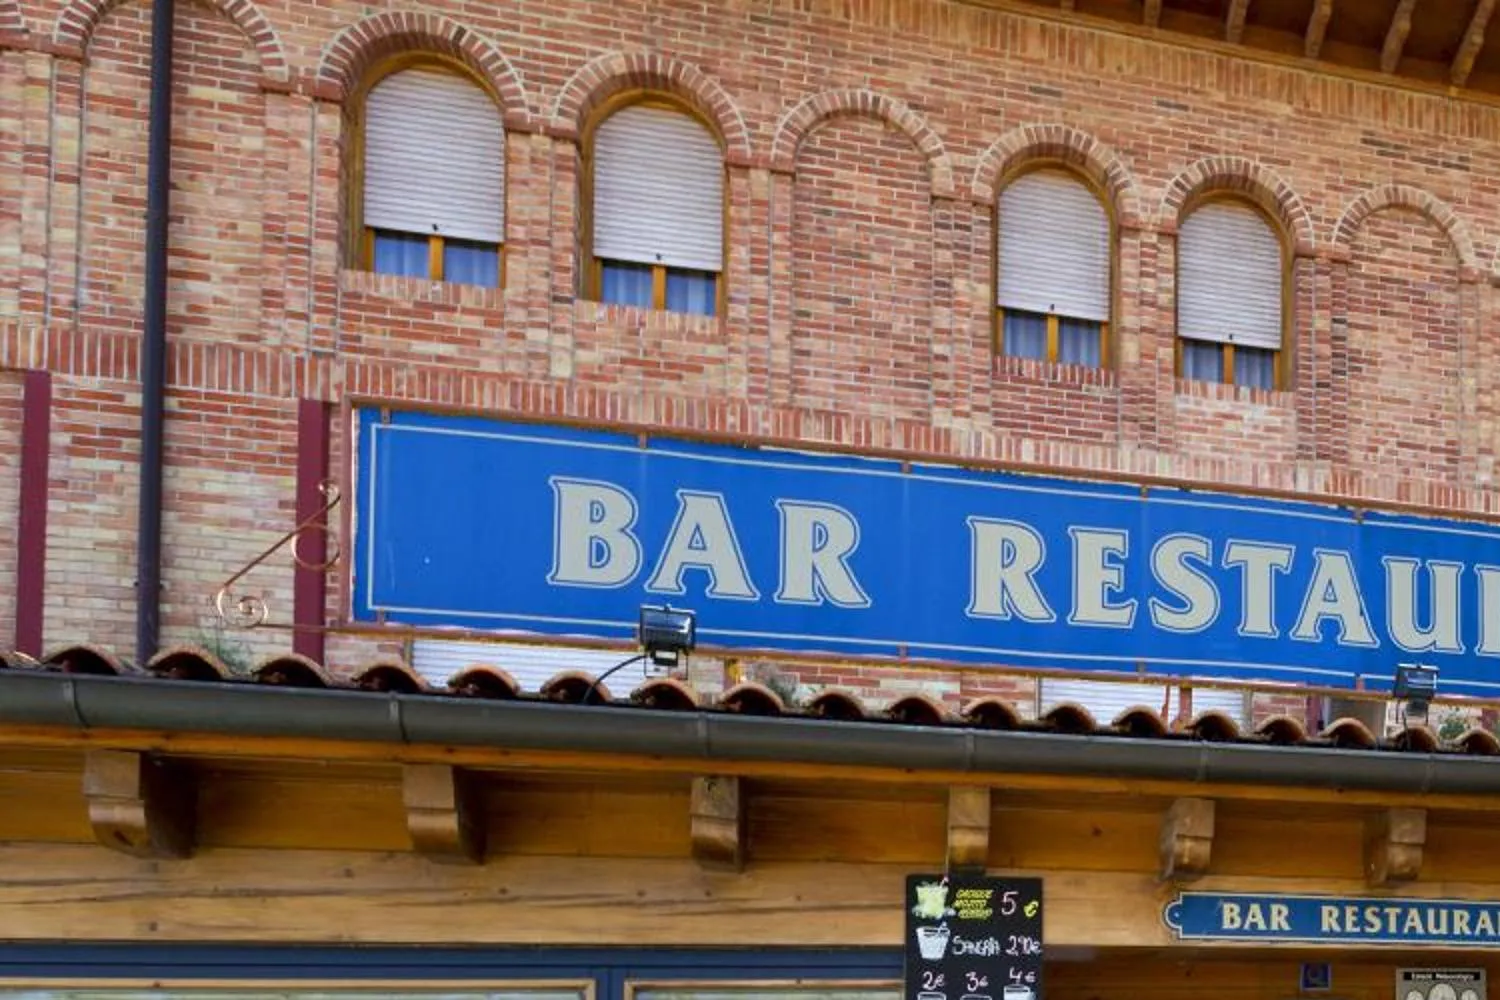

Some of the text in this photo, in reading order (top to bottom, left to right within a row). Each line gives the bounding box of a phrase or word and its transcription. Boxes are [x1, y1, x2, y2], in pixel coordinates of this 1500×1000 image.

[547, 475, 872, 609] BAR
[1001, 891, 1019, 916] 5
[1220, 901, 1292, 931] BAR
